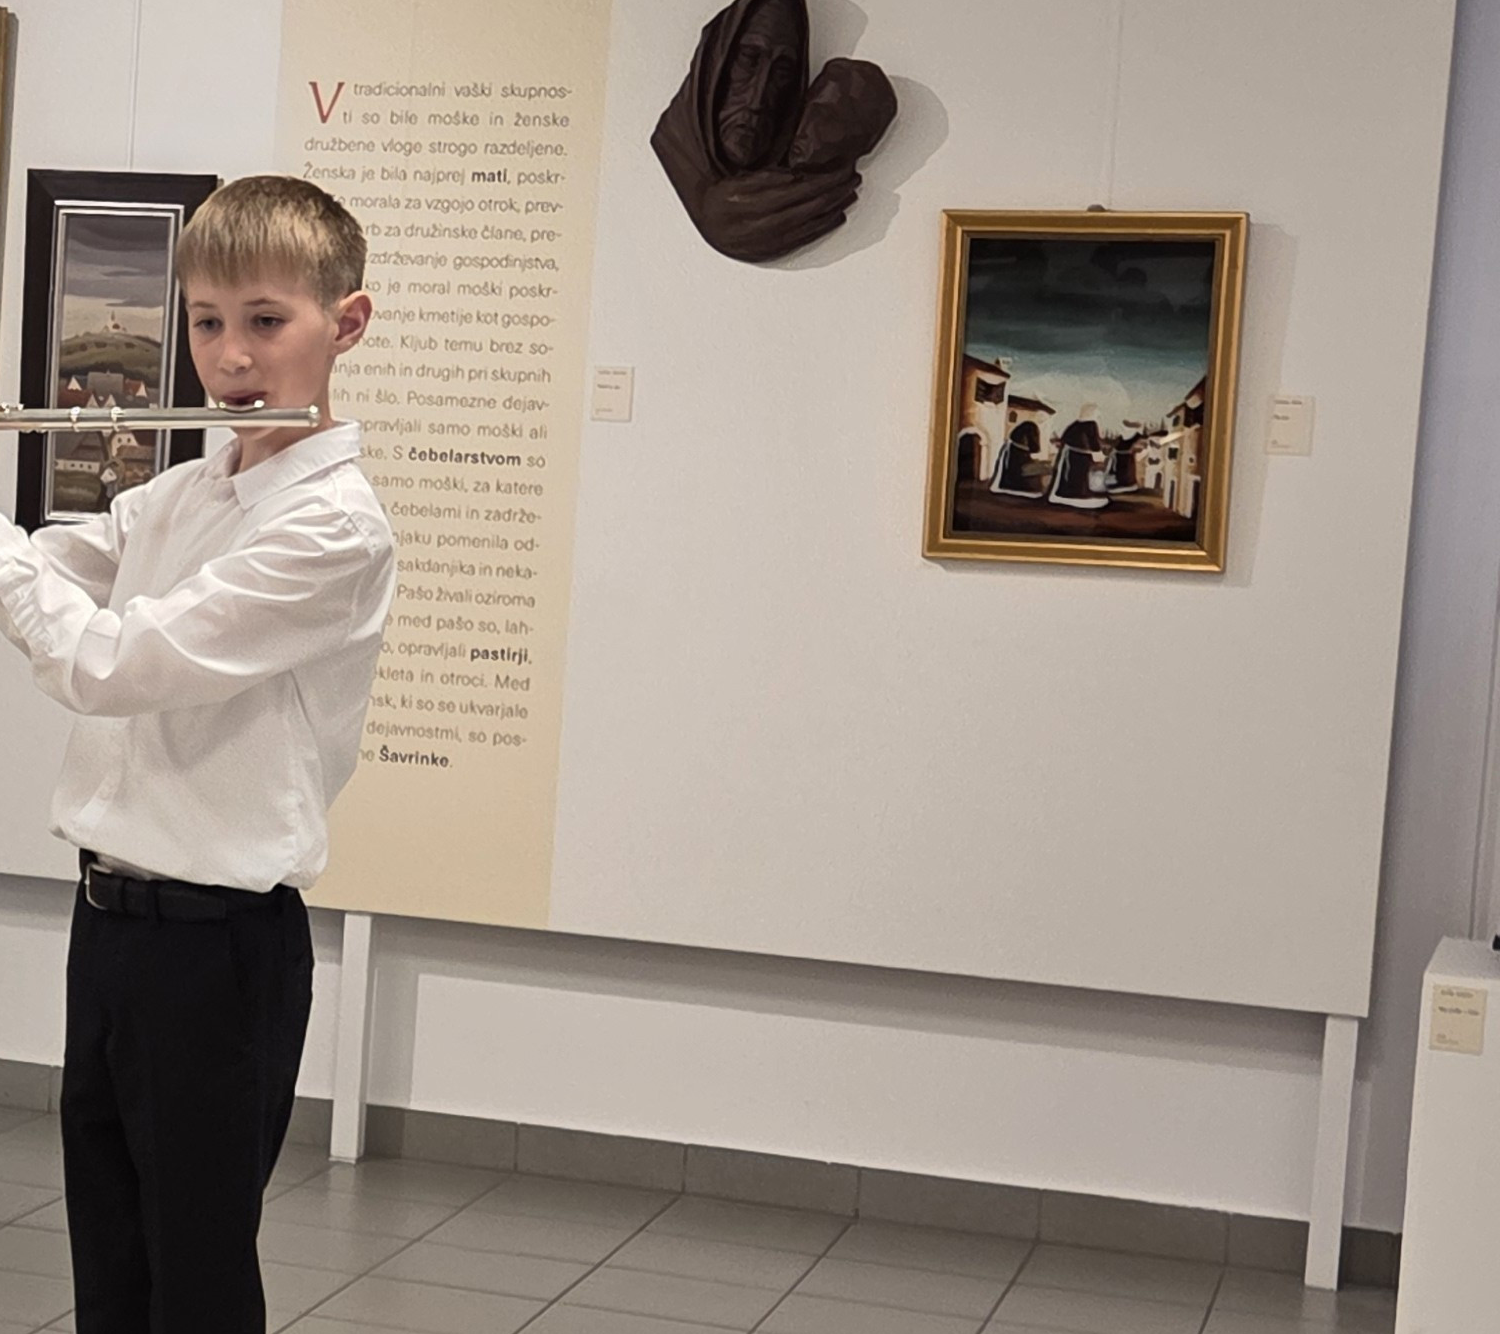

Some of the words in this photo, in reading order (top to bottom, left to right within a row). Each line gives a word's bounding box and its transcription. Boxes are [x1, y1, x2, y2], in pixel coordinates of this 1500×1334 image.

[308, 81, 346, 124] V
[354, 82, 445, 97] tradicionalni
[454, 82, 492, 98] vaški
[501, 83, 572, 101] skupnos-
[343, 111, 352, 124] ti
[362, 112, 380, 124] so
[390, 110, 418, 125] bile
[428, 110, 479, 126] moške
[490, 112, 503, 126] in
[514, 112, 569, 127] ženske
[305, 137, 375, 152] družbene
[381, 138, 422, 157] vloge
[428, 141, 477, 158] strogo
[484, 140, 567, 158] razdeljene.
[302, 161, 356, 180] Ženska
[361, 166, 375, 183] je
[381, 166, 407, 181] bila
[413, 168, 465, 186] najprej
[471, 168, 511, 185] mati,
[517, 169, 565, 186] poskr-
[350, 195, 401, 209] morala
[404, 198, 421, 209] za
[425, 196, 475, 214] vzgojo
[478, 198, 520, 214] otrok,
[525, 201, 563, 215] prev-
[384, 226, 401, 237] za
[404, 223, 478, 239] družinske
[481, 225, 526, 242] člane,
[531, 229, 561, 243] pre-
[370, 251, 447, 268] zdrževanje
[453, 254, 559, 272] gospodinjstva,
[387, 279, 401, 295] je
[408, 281, 450, 295] moral
[457, 281, 503, 296] moški
[509, 283, 557, 299] poskr-
[419, 308, 473, 326] kmetije
[476, 310, 498, 325] kot
[501, 314, 555, 329] gospo-
[400, 335, 438, 352] Kljub
[445, 338, 483, 352] temu
[490, 339, 523, 354] brez
[529, 343, 553, 355] so-
[364, 363, 395, 376] enih
[400, 363, 412, 377] in
[416, 364, 464, 382] drugih
[468, 369, 487, 382] pri
[491, 367, 551, 384] skupnih
[356, 389, 369, 402] ni
[375, 389, 400, 404] šlo.
[407, 390, 497, 409] Posamezne
[502, 395, 549, 413] dejav-
[428, 423, 471, 436] samo
[477, 423, 523, 438] moški
[529, 425, 547, 439] ali
[393, 445, 403, 460] S
[408, 446, 521, 466] čebelarstvom
[527, 456, 545, 468] so
[372, 475, 414, 489] samo
[419, 476, 468, 493] moški,
[473, 481, 490, 493] za
[496, 479, 543, 496] katere
[390, 501, 461, 519] čebelami
[466, 506, 479, 519] in
[484, 508, 541, 524] zadrže-
[437, 534, 508, 550] pomenila
[514, 537, 539, 551] od-
[479, 563, 492, 576] in
[496, 564, 537, 579] neka-
[397, 584, 433, 601] Pašo
[436, 586, 472, 603] živali
[475, 591, 535, 608] oziroma
[398, 615, 431, 628] med
[436, 616, 474, 631] pašo
[478, 621, 500, 635] so,
[505, 620, 533, 635] lah-
[398, 643, 466, 660] opravljali
[421, 669, 434, 683] in
[440, 672, 487, 688] otroci.
[494, 674, 530, 691] Med
[401, 694, 412, 708] ki
[416, 699, 434, 711] so
[438, 700, 456, 713] se
[459, 700, 528, 720] ukvarjale
[367, 721, 462, 743] dejavnostmi,
[468, 731, 487, 743] so
[493, 732, 526, 746] pos-
[379, 744, 452, 768] Šavrinke.
